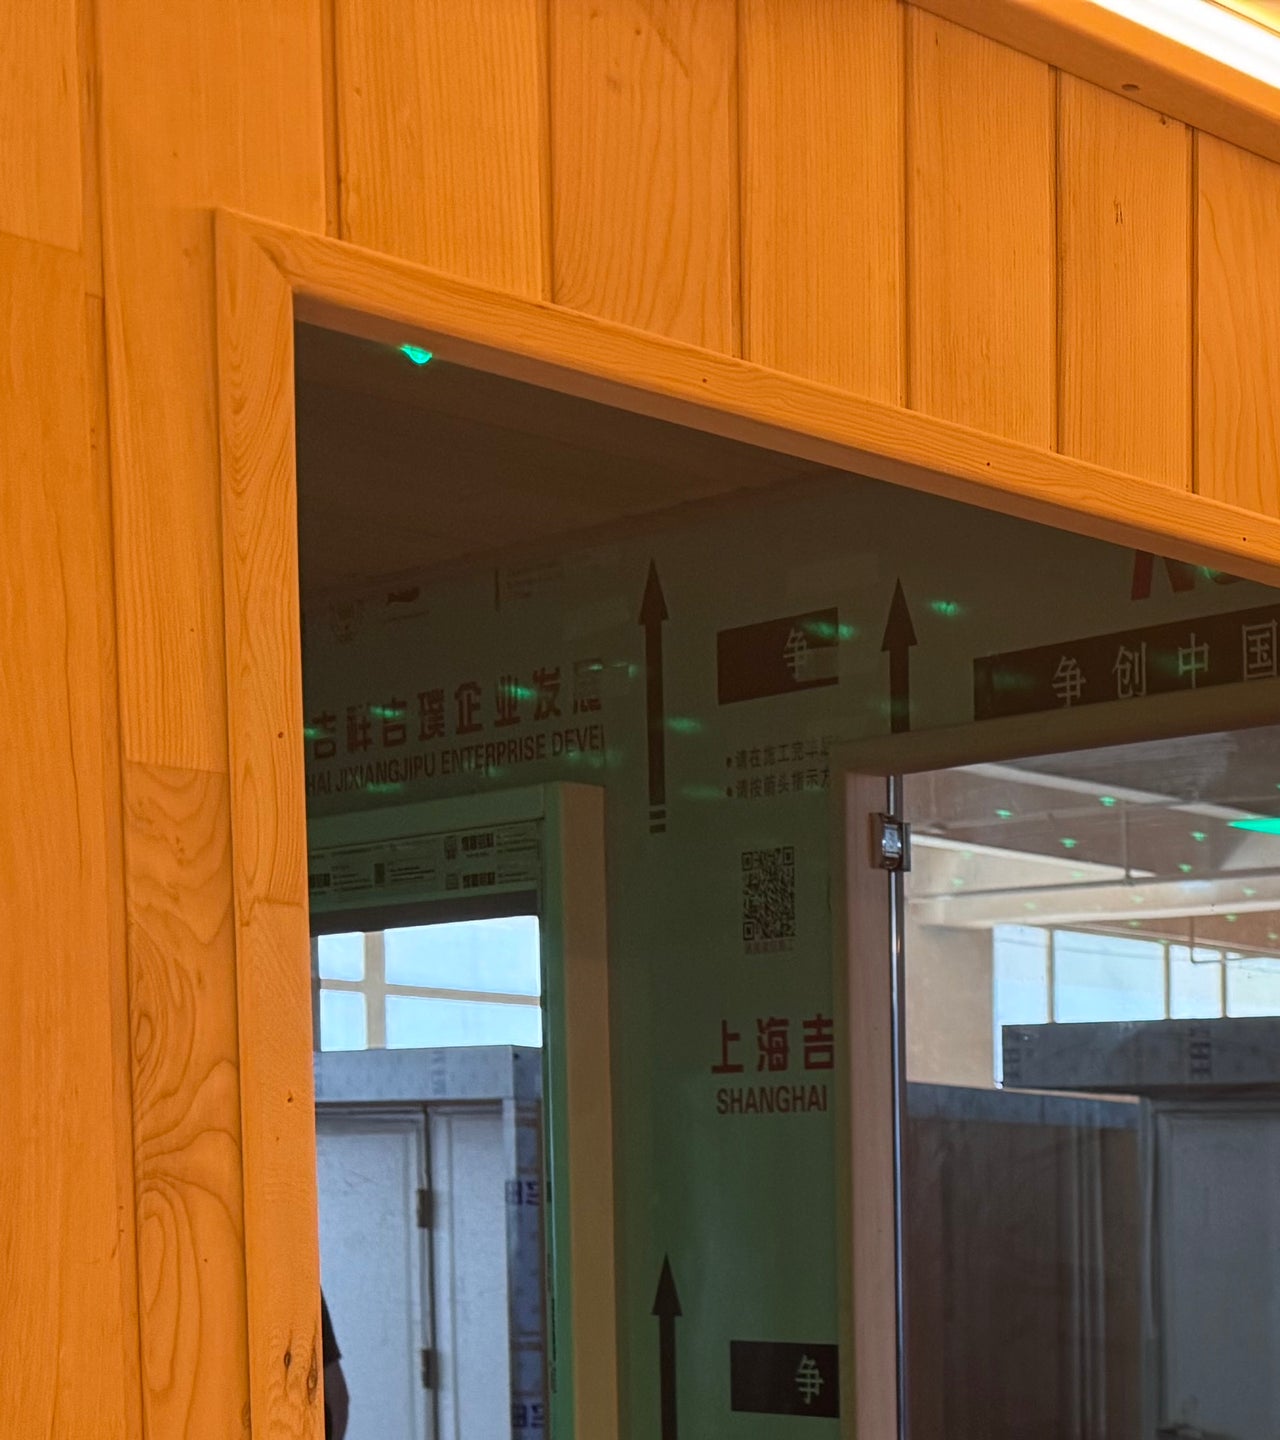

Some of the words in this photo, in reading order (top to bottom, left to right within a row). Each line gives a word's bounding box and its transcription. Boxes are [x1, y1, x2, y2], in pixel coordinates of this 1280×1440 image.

[335, 752, 436, 792] JIXIANGJIPU
[441, 732, 547, 774] ENTERPRISE
[711, 1013, 834, 1075] 上海吉
[717, 1084, 828, 1115] SHANGHAI
[795, 1353, 825, 1405] 争
